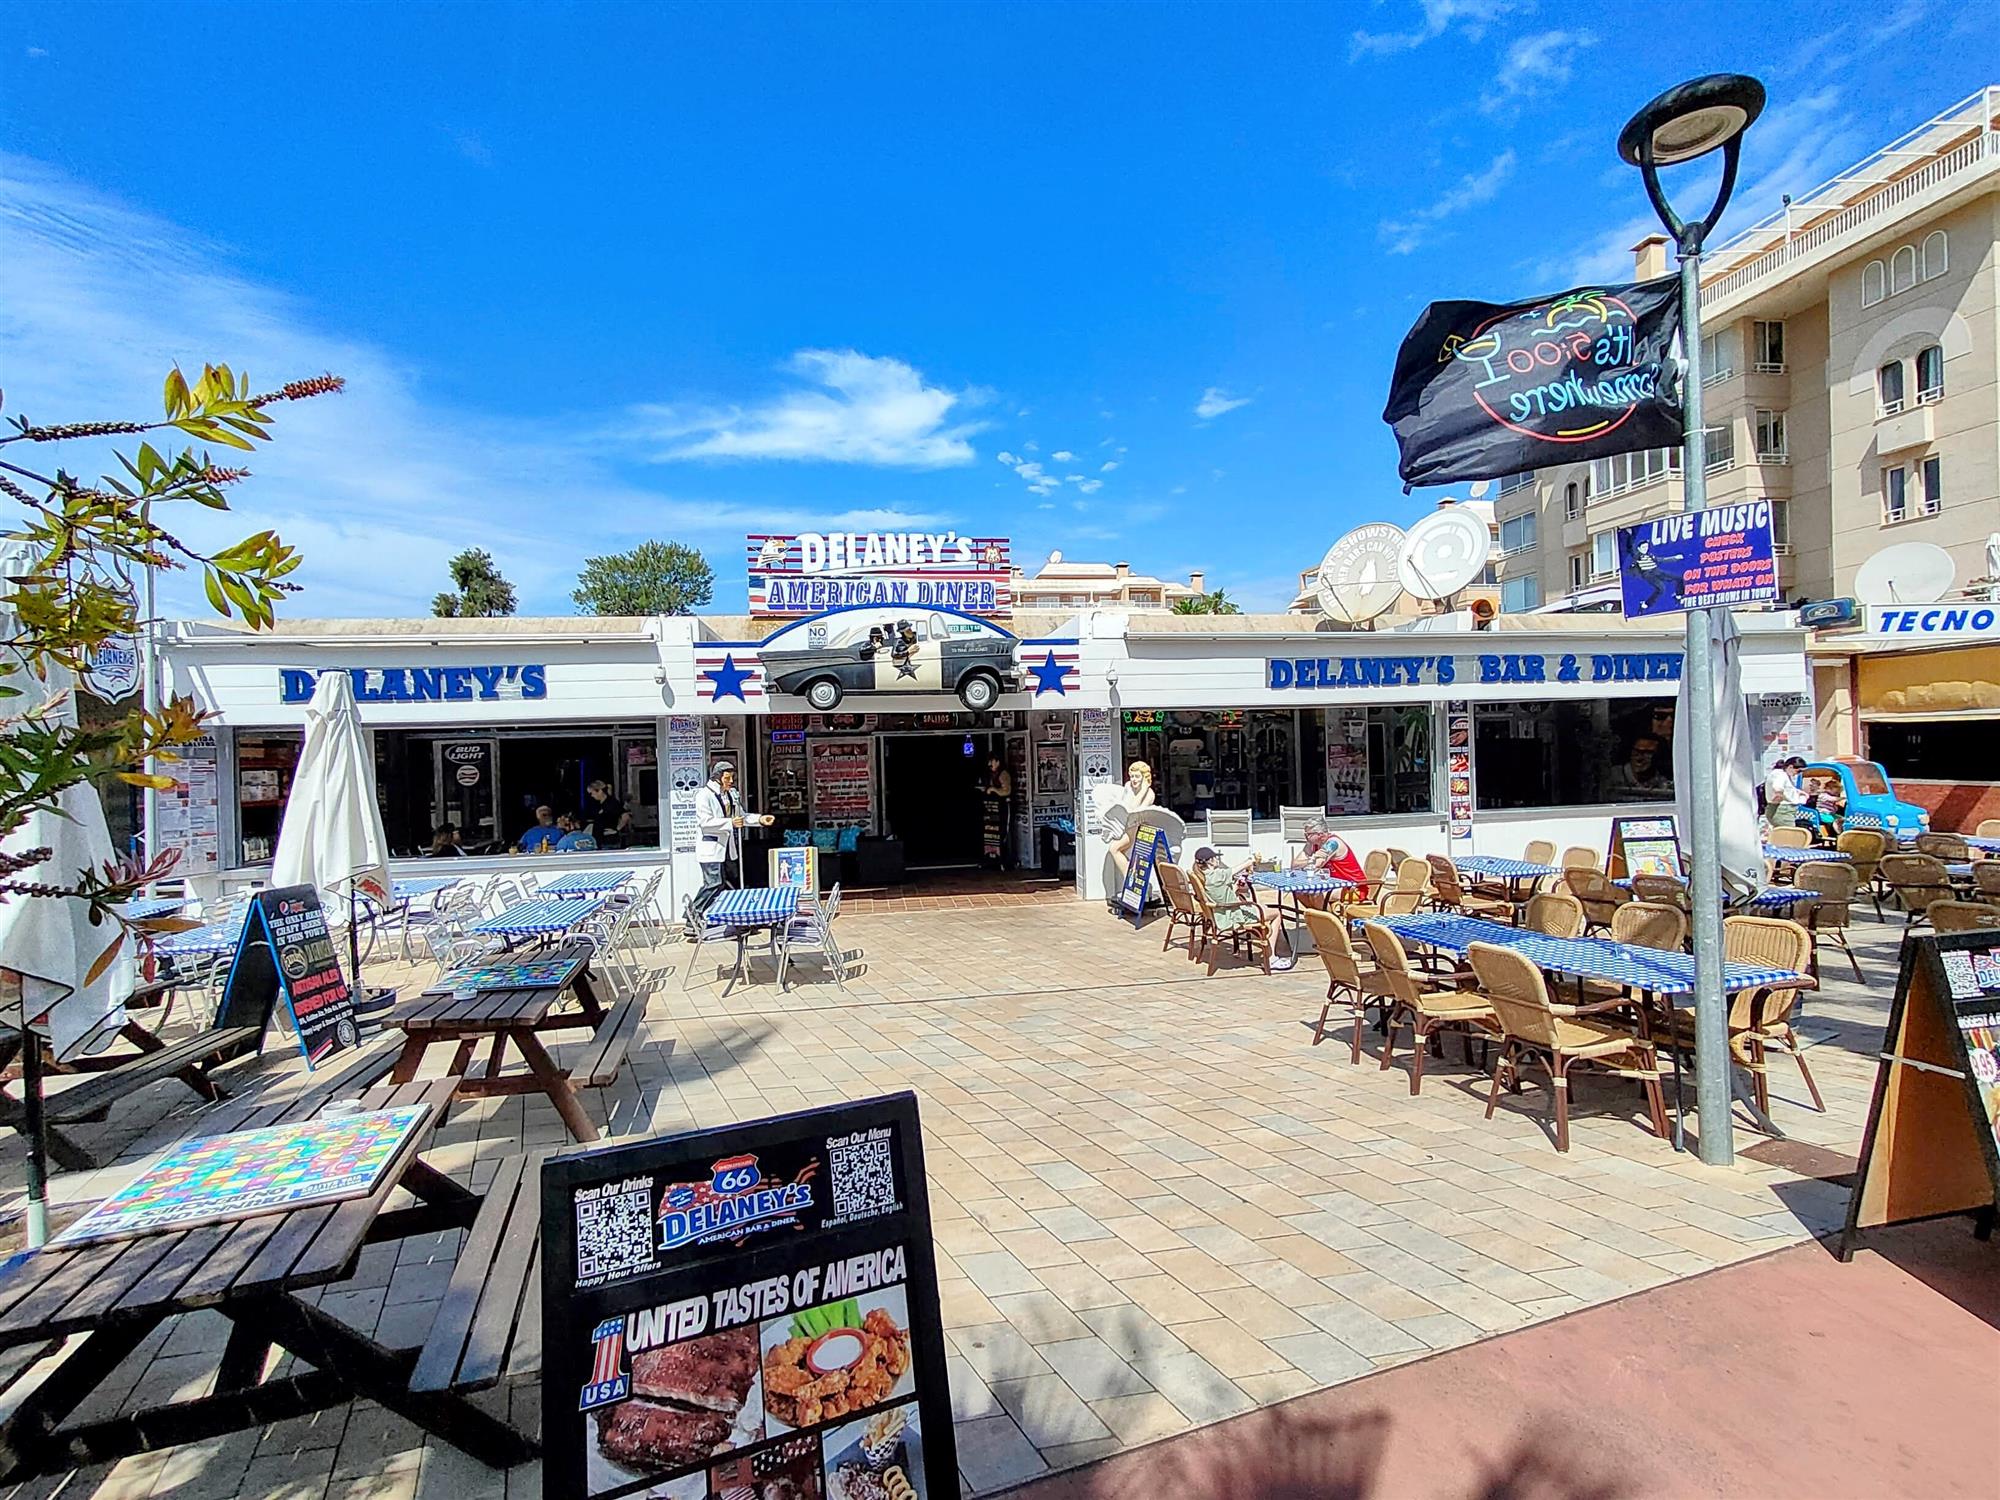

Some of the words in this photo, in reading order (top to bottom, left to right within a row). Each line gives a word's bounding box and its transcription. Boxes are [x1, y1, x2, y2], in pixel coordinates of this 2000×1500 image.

[1651, 514, 1694, 546] LIVE
[1700, 502, 1768, 537] MUSIC
[1705, 532, 1746, 548] CHECK
[796, 531, 973, 572] DELANEY'S
[1700, 546, 1753, 564] POSTERS
[1683, 568, 1701, 580] ON
[1704, 564, 1728, 577] THE
[1731, 559, 1772, 573] DOORS
[767, 580, 911, 610] AMERICAN
[917, 580, 997, 609] DINER
[1685, 582, 1708, 595] FOR
[1711, 576, 1753, 590] WHATS
[1756, 574, 1774, 585] ON
[1698, 594, 1715, 606] BEST
[1716, 590, 1740, 603] SHOWS
[1741, 589, 1750, 600] IN
[809, 627, 826, 637] NO
[1880, 610, 1995, 632] TECNO
[1270, 655, 1455, 689] DELANEY'S
[1478, 654, 1545, 683] BAR
[1557, 655, 1582, 684] &
[281, 666, 546, 702] DLANEY'S
[450, 752, 485, 760] LIGHT
[776, 745, 802, 754] DINER
[269, 918, 285, 929] THE
[285, 913, 304, 926] ONLY
[305, 909, 323, 920] REAL
[276, 924, 299, 937] CRAFT
[300, 918, 322, 931] BEERS
[276, 936, 286, 946] IN
[287, 932, 304, 943] THIS
[304, 926, 326, 939] TOWN
[322, 988, 338, 1005] FOR
[336, 985, 348, 999] US
[825, 1137, 849, 1149] Scan
[850, 1132, 867, 1145] Our
[868, 1127, 892, 1140] Menu
[573, 1187, 601, 1203] Scan
[601, 1183, 621, 1197] Our
[621, 1175, 654, 1193] Drinks
[721, 1168, 751, 1190] 66
[196, 1194, 288, 1217] DRINKS
[660, 1183, 812, 1245] DELANEY'S
[881, 1201, 904, 1215] English
[698, 1229, 744, 1246] AMERICAN
[745, 1224, 763, 1234] BAR
[771, 1216, 797, 1227] DINER
[574, 1274, 606, 1289] Happy
[607, 1267, 630, 1281] Hour
[633, 1261, 662, 1275] Offers
[626, 1295, 709, 1353] UNITED
[713, 1274, 790, 1330] TASTES
[793, 1270, 818, 1307] OF
[821, 1246, 908, 1301] AMERICA
[585, 1379, 625, 1404] USA
